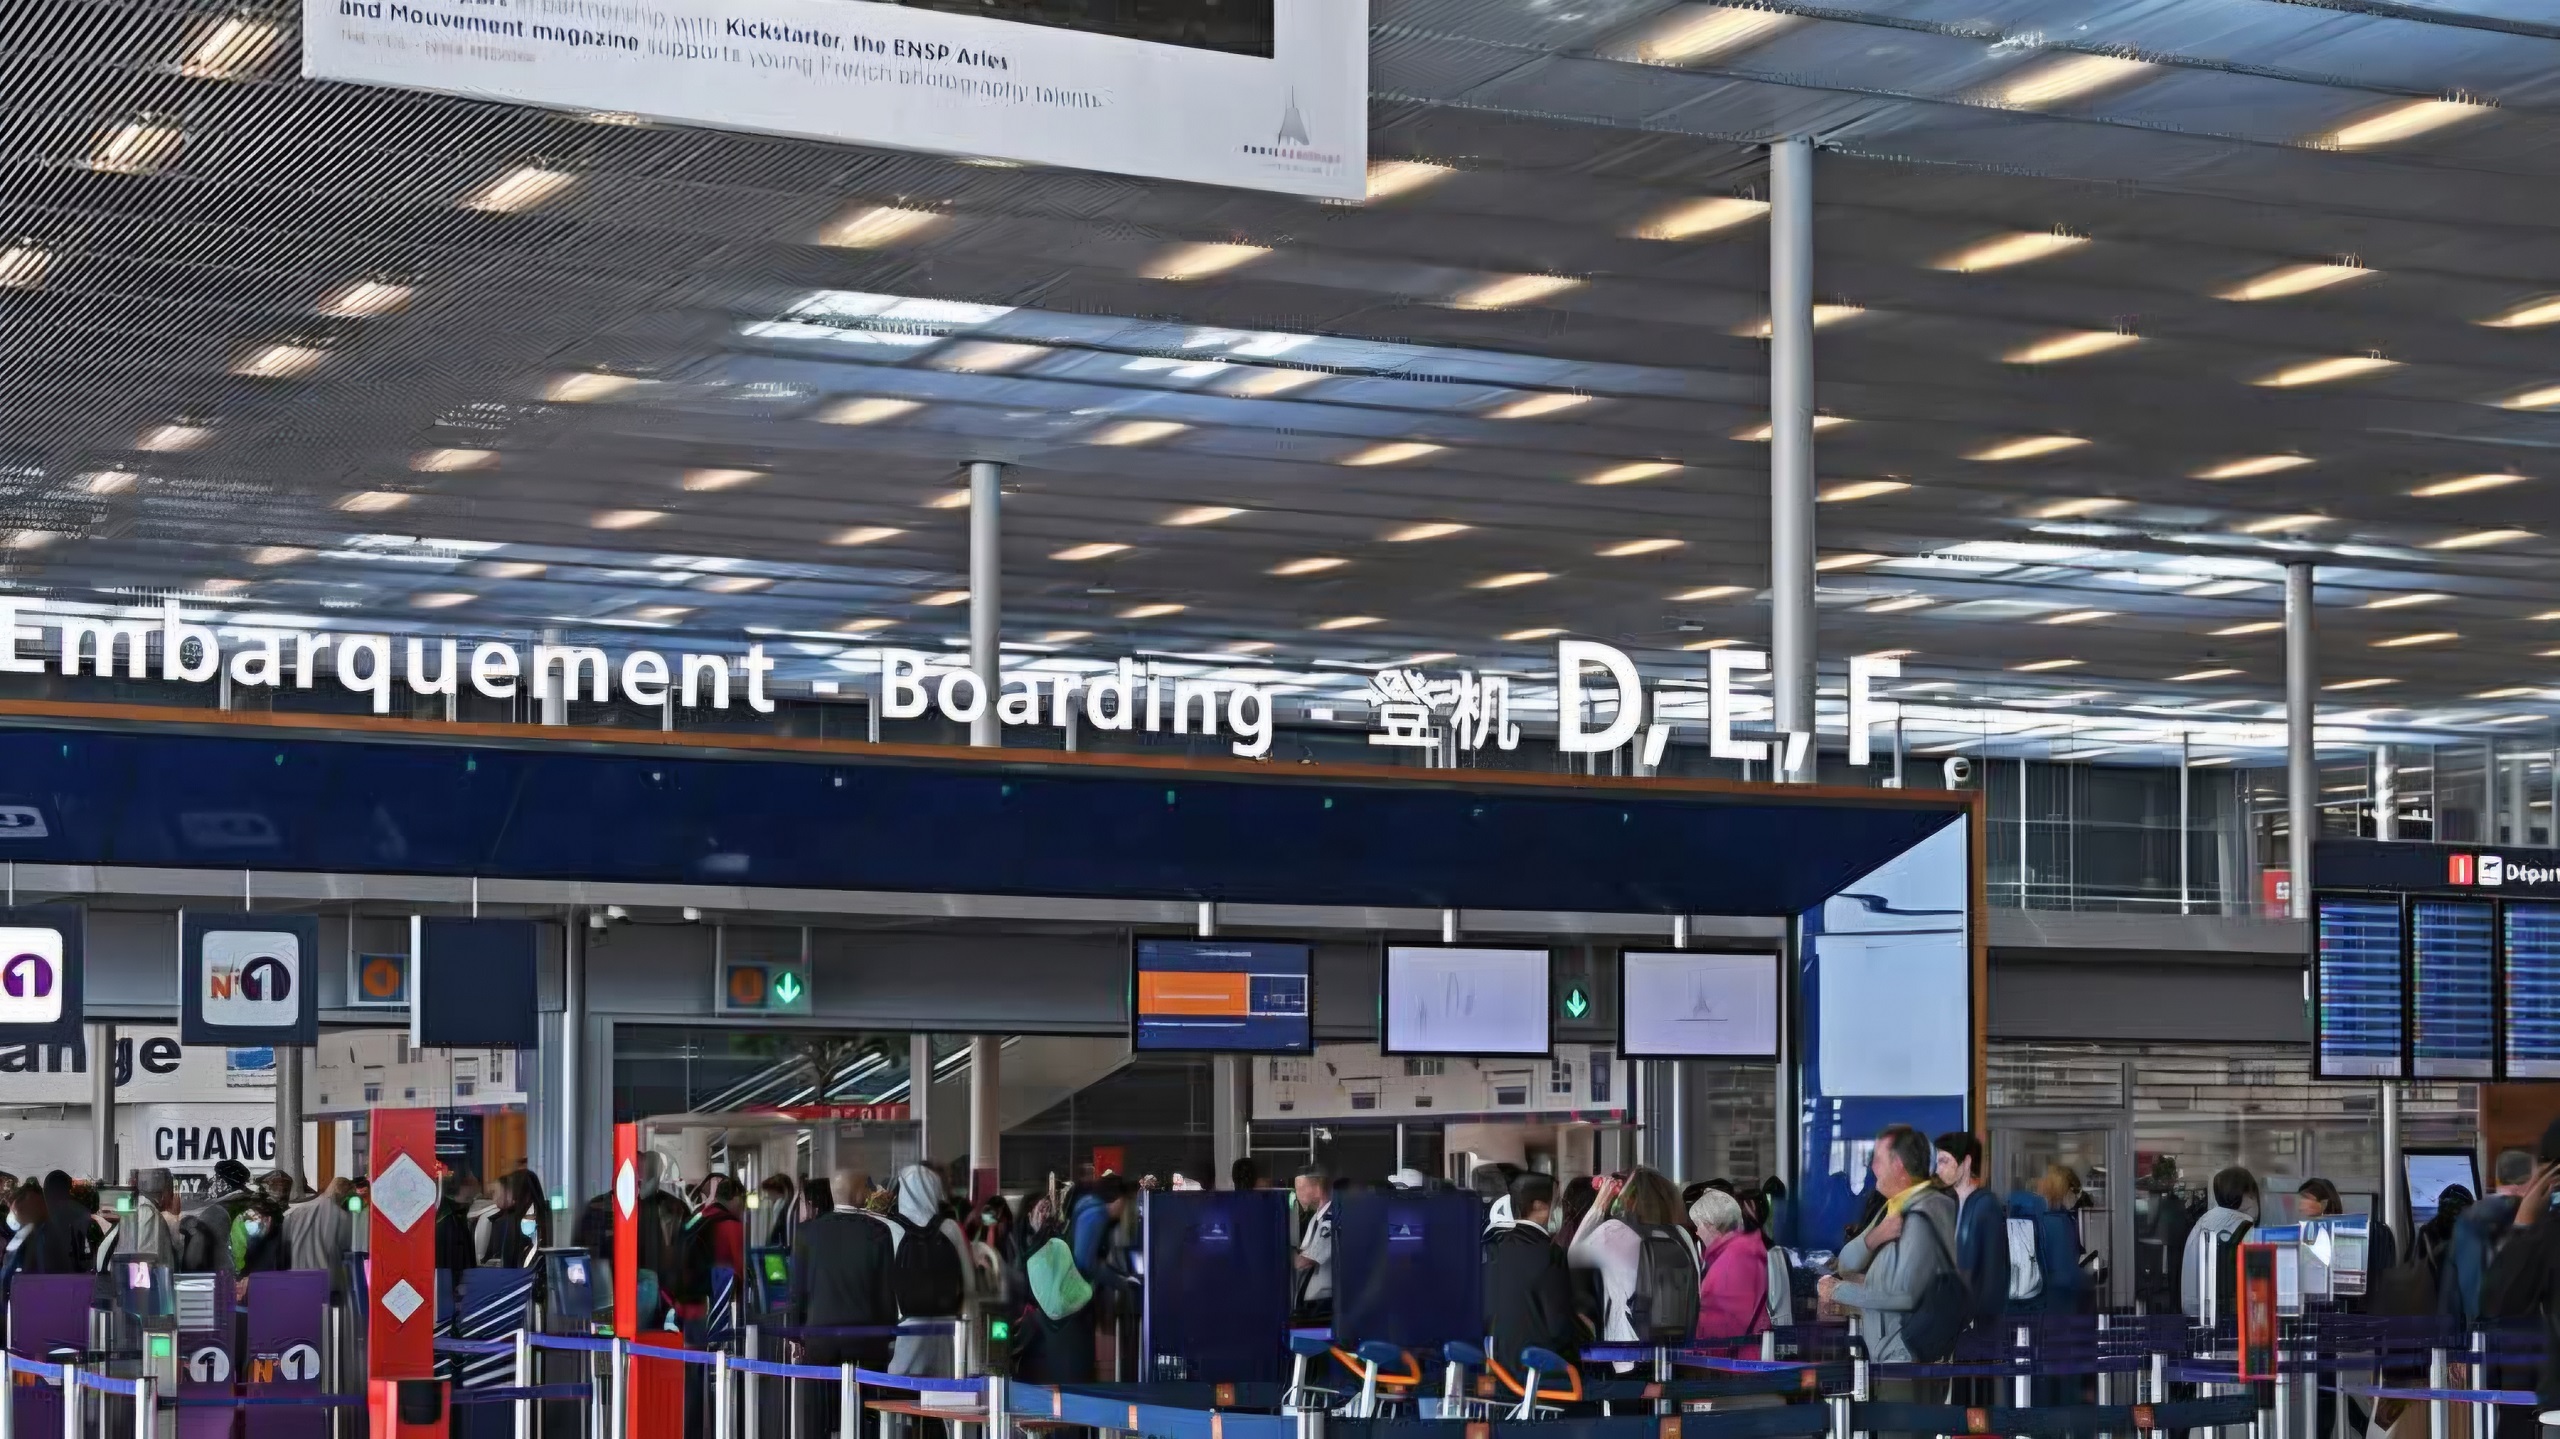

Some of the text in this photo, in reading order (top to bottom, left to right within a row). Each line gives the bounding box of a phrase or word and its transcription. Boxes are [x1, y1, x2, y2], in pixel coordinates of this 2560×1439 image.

[0, 597, 776, 714] Embarquement
[881, 649, 1272, 758] Boarding
[1848, 656, 1902, 766] F
